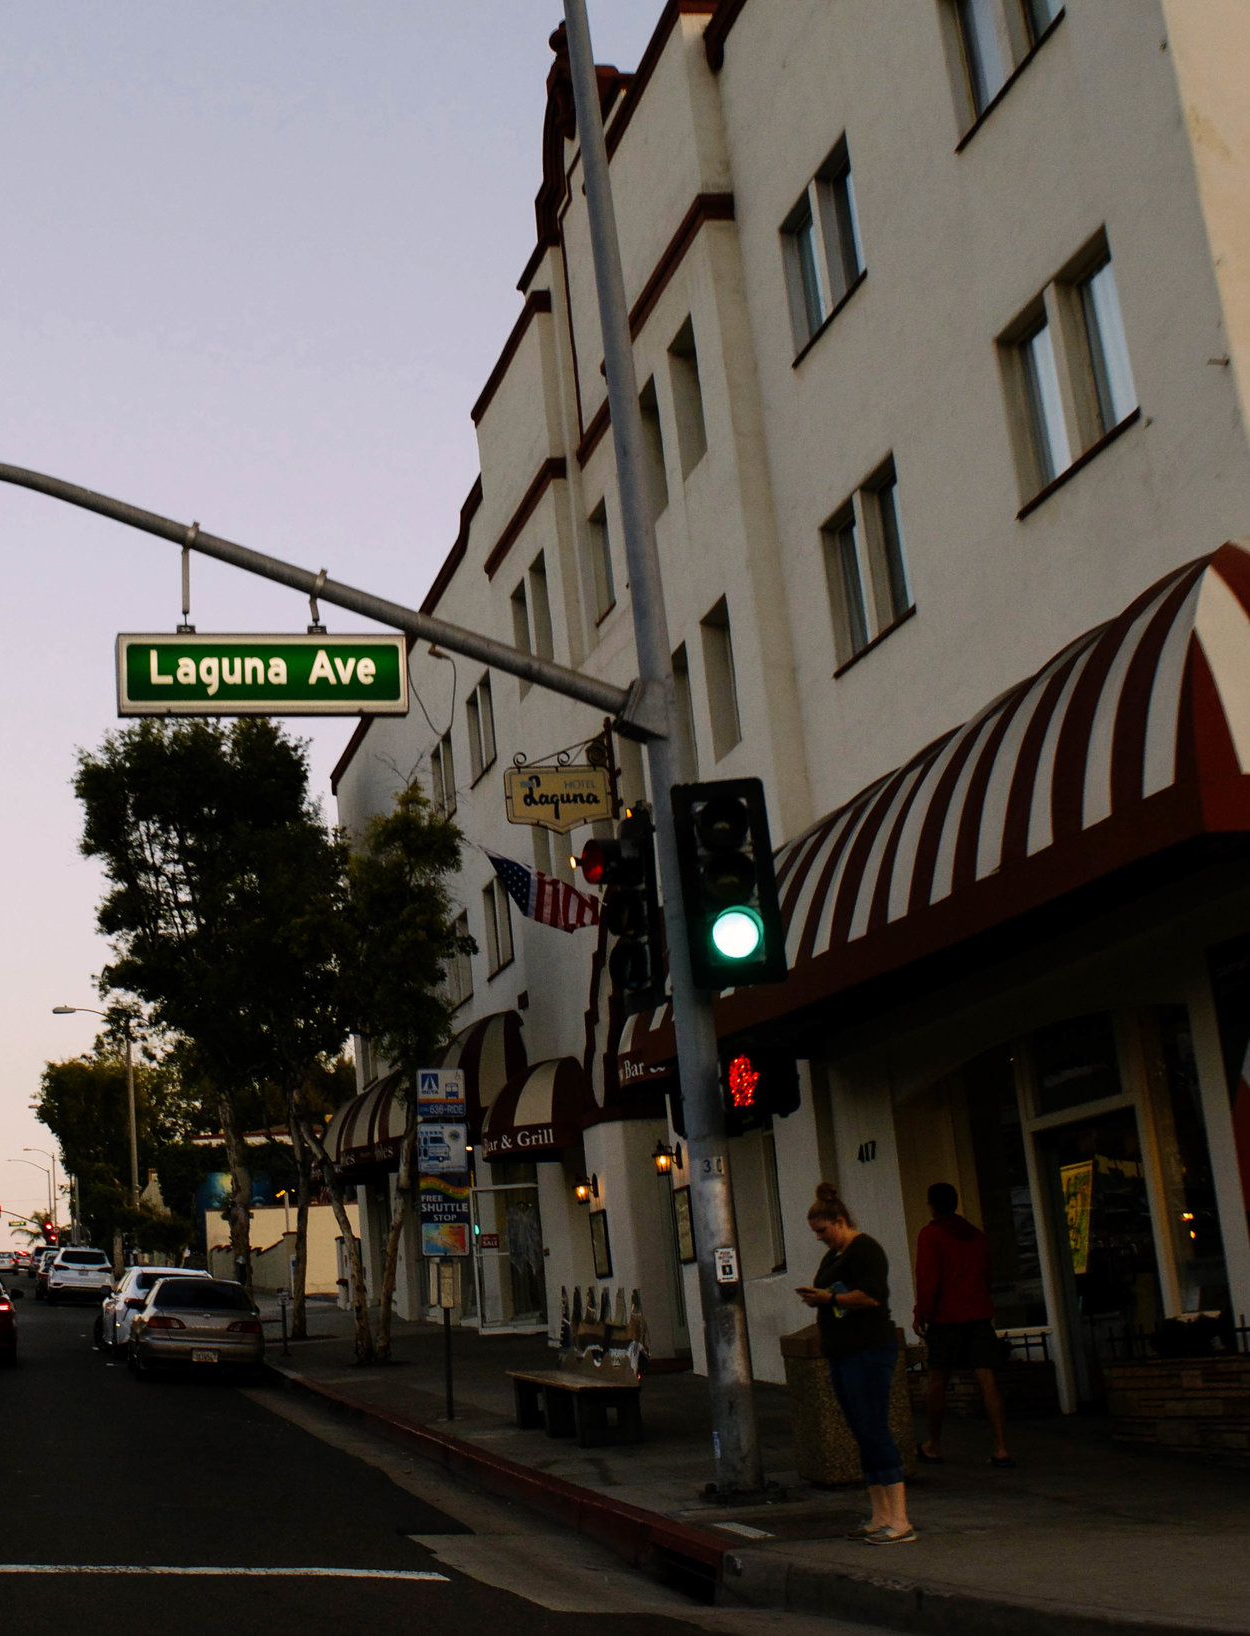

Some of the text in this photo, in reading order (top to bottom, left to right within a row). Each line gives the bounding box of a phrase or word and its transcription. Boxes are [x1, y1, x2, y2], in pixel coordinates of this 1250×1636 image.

[149, 649, 376, 696] Laguna Ave
[564, 780, 595, 790] HOTEL
[523, 775, 600, 819] Laguna
[624, 1059, 645, 1079] Bar
[501, 1134, 513, 1150] &
[517, 1128, 555, 1147] Grill
[858, 1141, 876, 1162] 417
[421, 1194, 444, 1202] FREE
[421, 1203, 469, 1213] SHUTTLE
[433, 1214, 457, 1222] STOP
